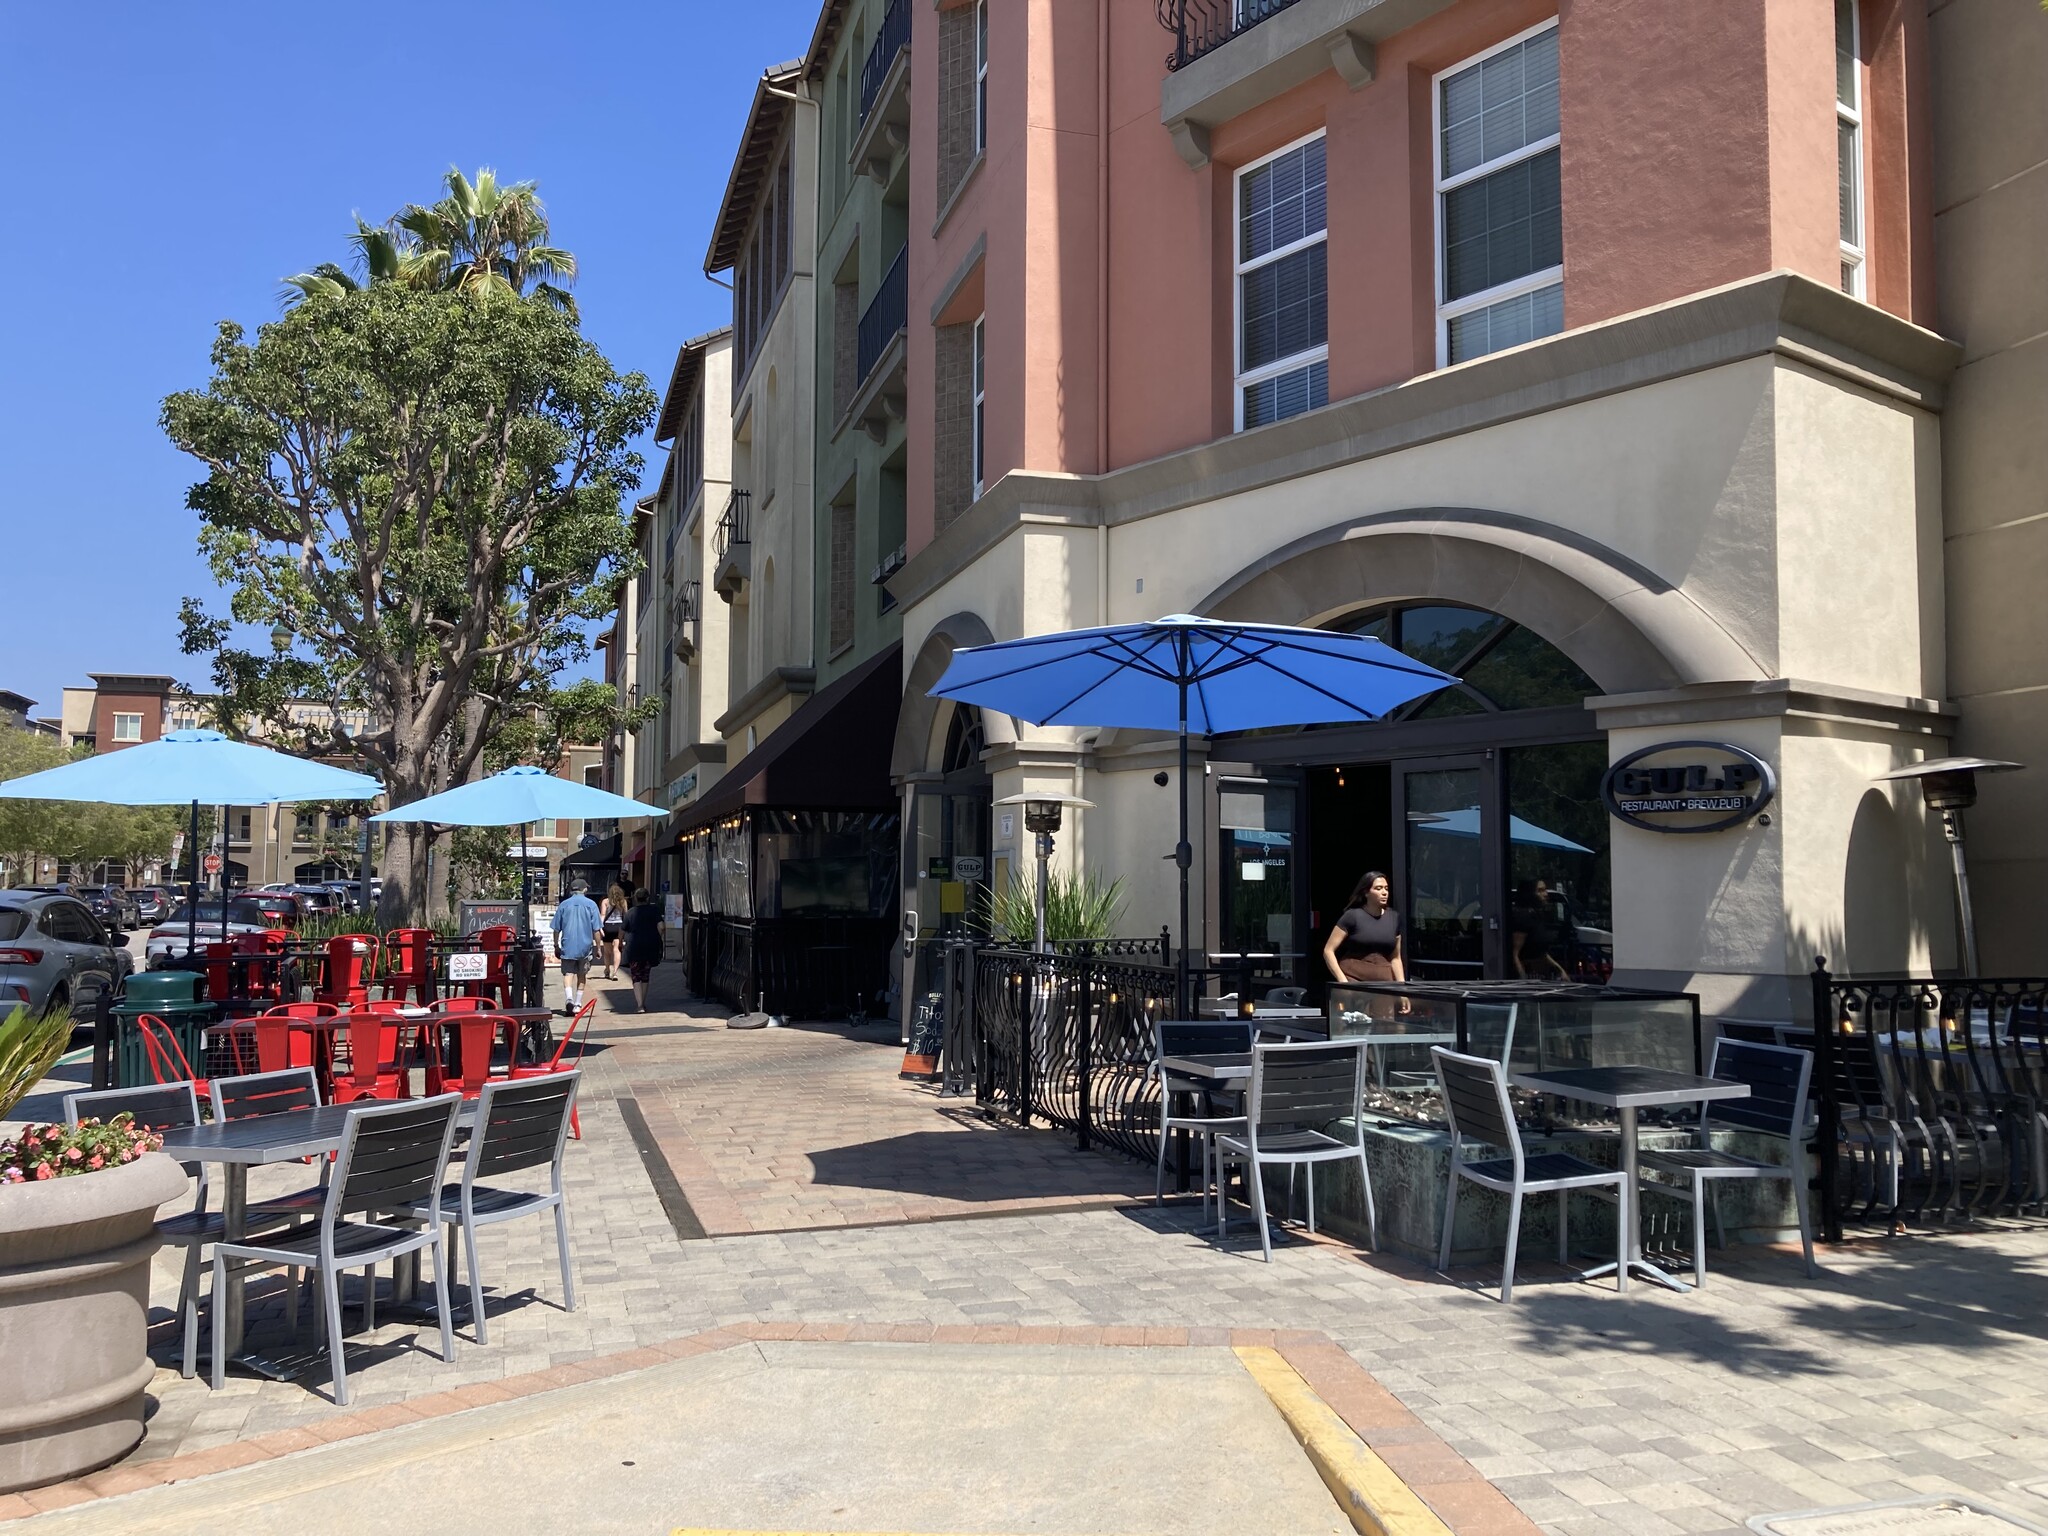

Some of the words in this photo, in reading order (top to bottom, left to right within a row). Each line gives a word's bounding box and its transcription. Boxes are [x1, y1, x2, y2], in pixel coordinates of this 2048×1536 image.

[1613, 764, 1761, 795] GULP
[1620, 800, 1681, 812] RESTAURANT
[1687, 799, 1718, 810] BREW
[1719, 797, 1741, 809] PUB
[468, 915, 508, 936] Classic
